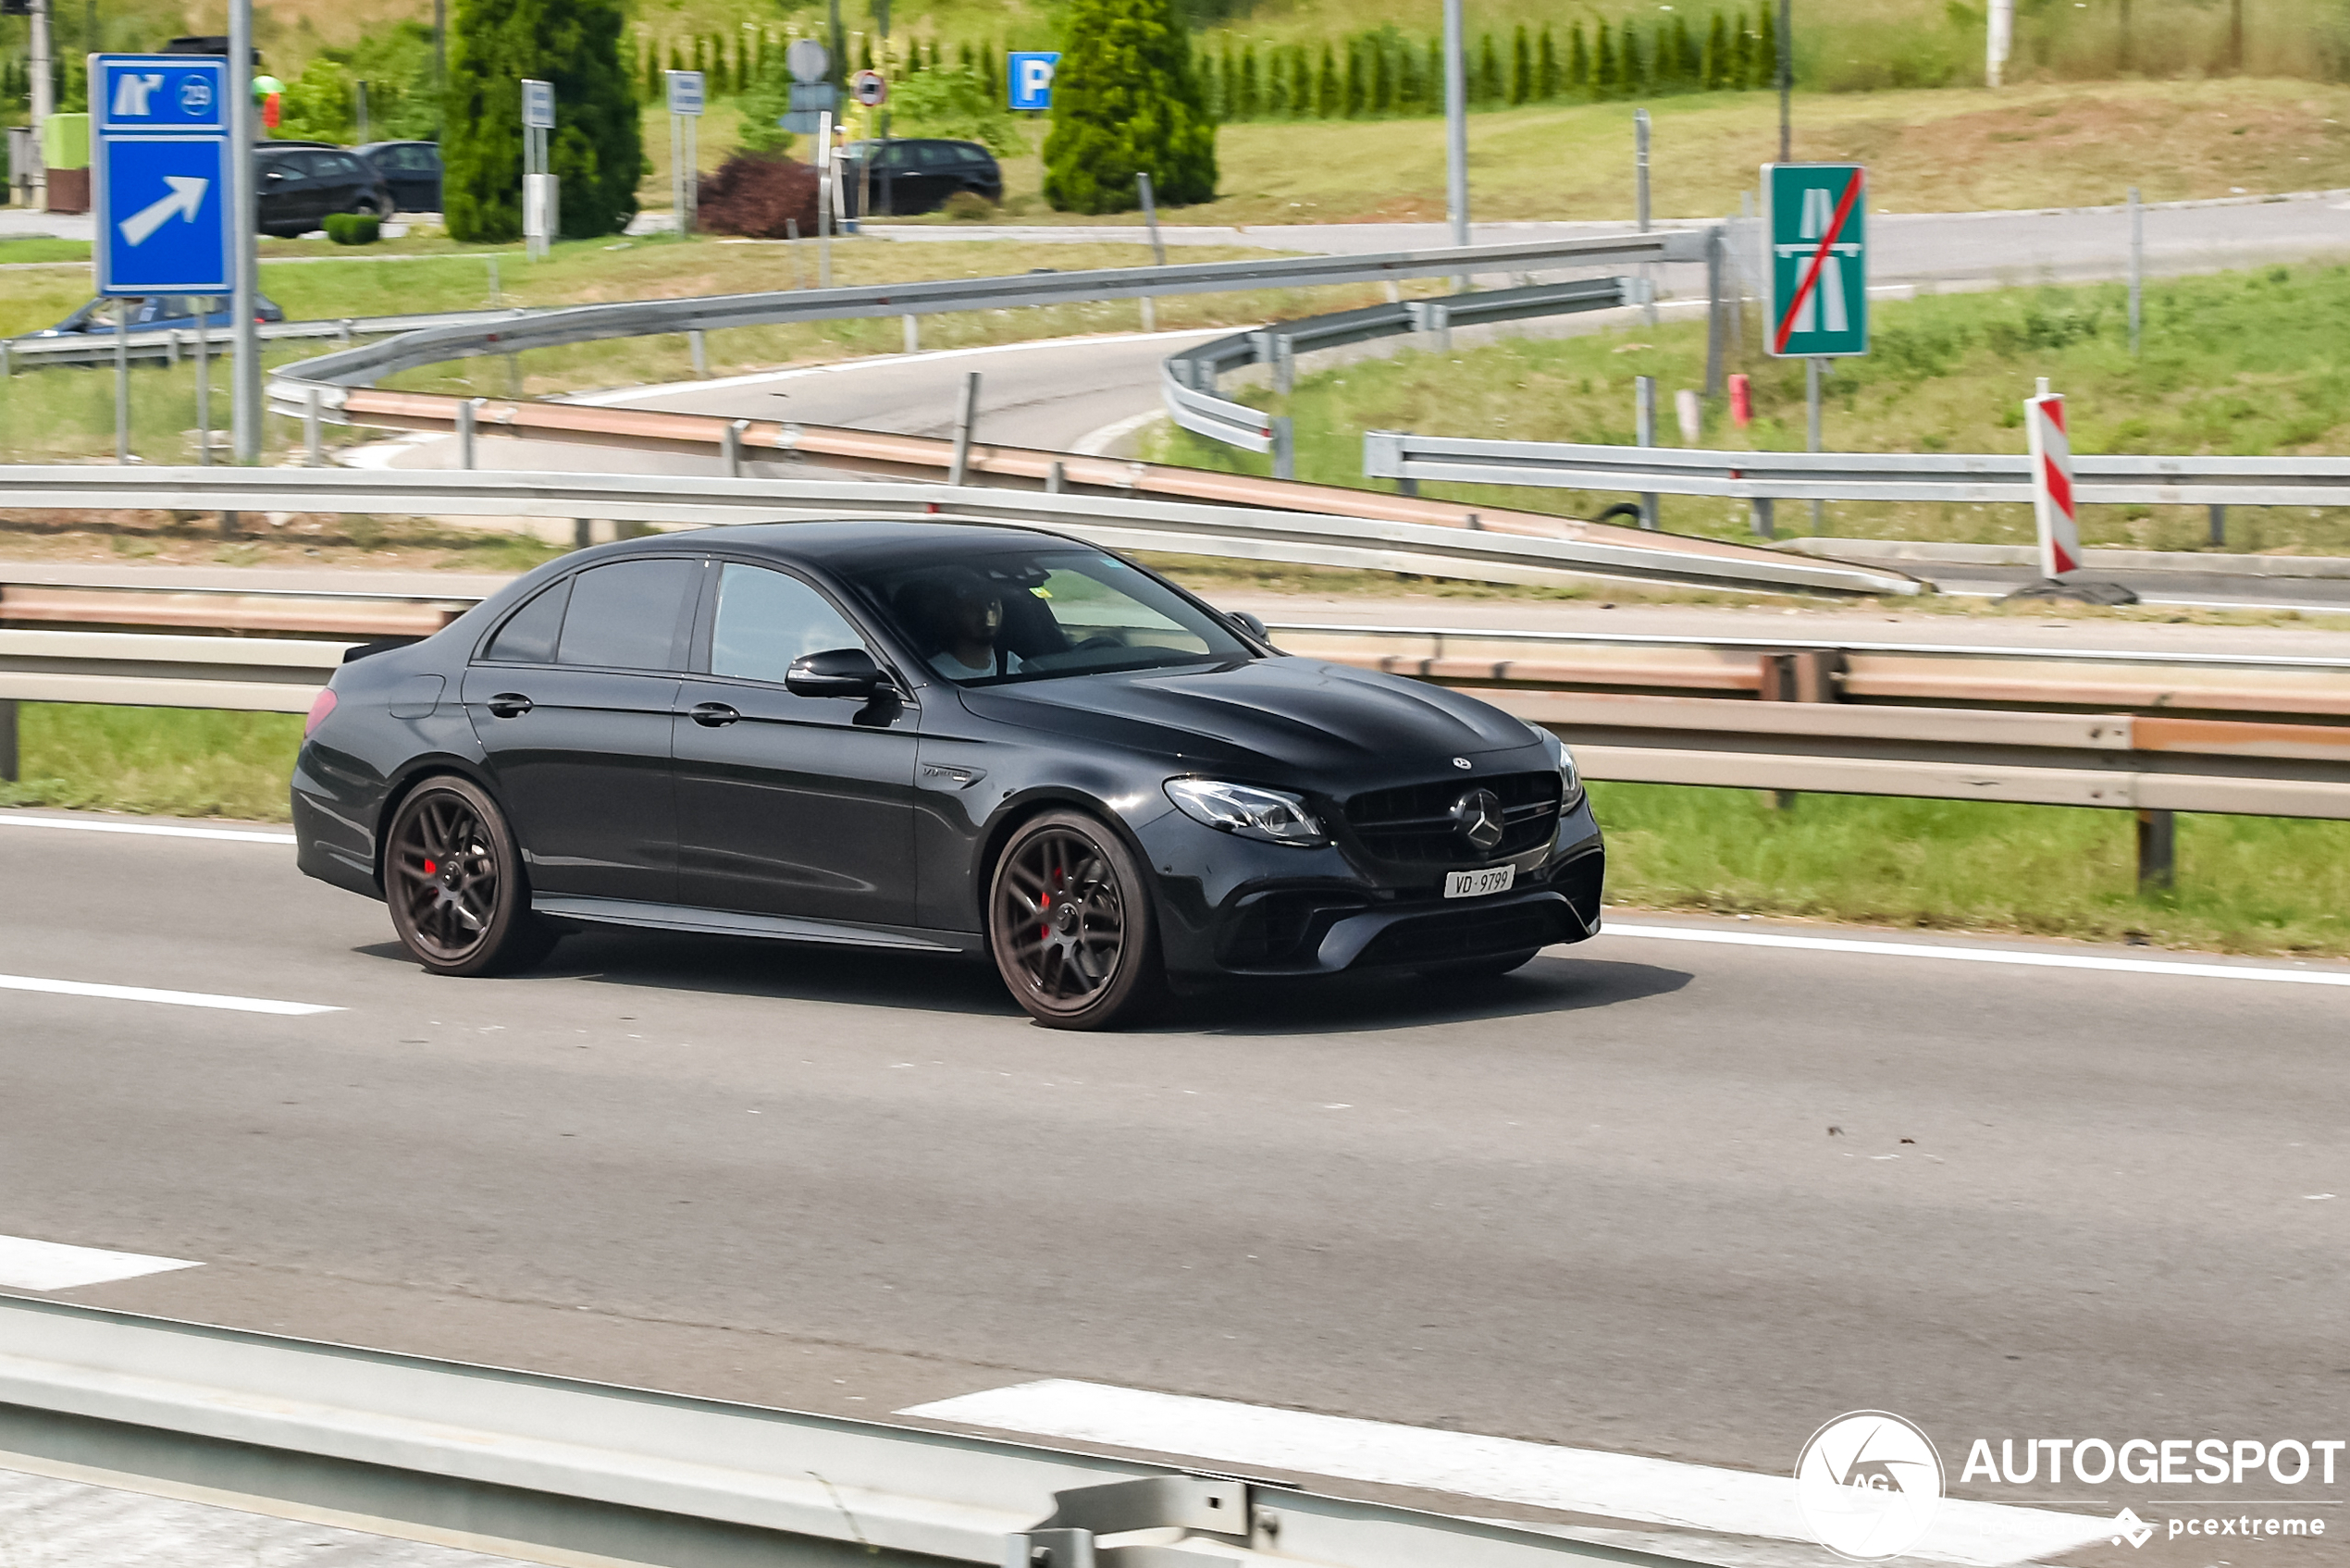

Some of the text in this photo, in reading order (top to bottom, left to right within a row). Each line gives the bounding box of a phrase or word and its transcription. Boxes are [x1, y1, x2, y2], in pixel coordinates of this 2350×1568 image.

[1021, 59, 1054, 101] P
[1455, 875, 1472, 894] VD
[1480, 870, 1508, 893] 9799
